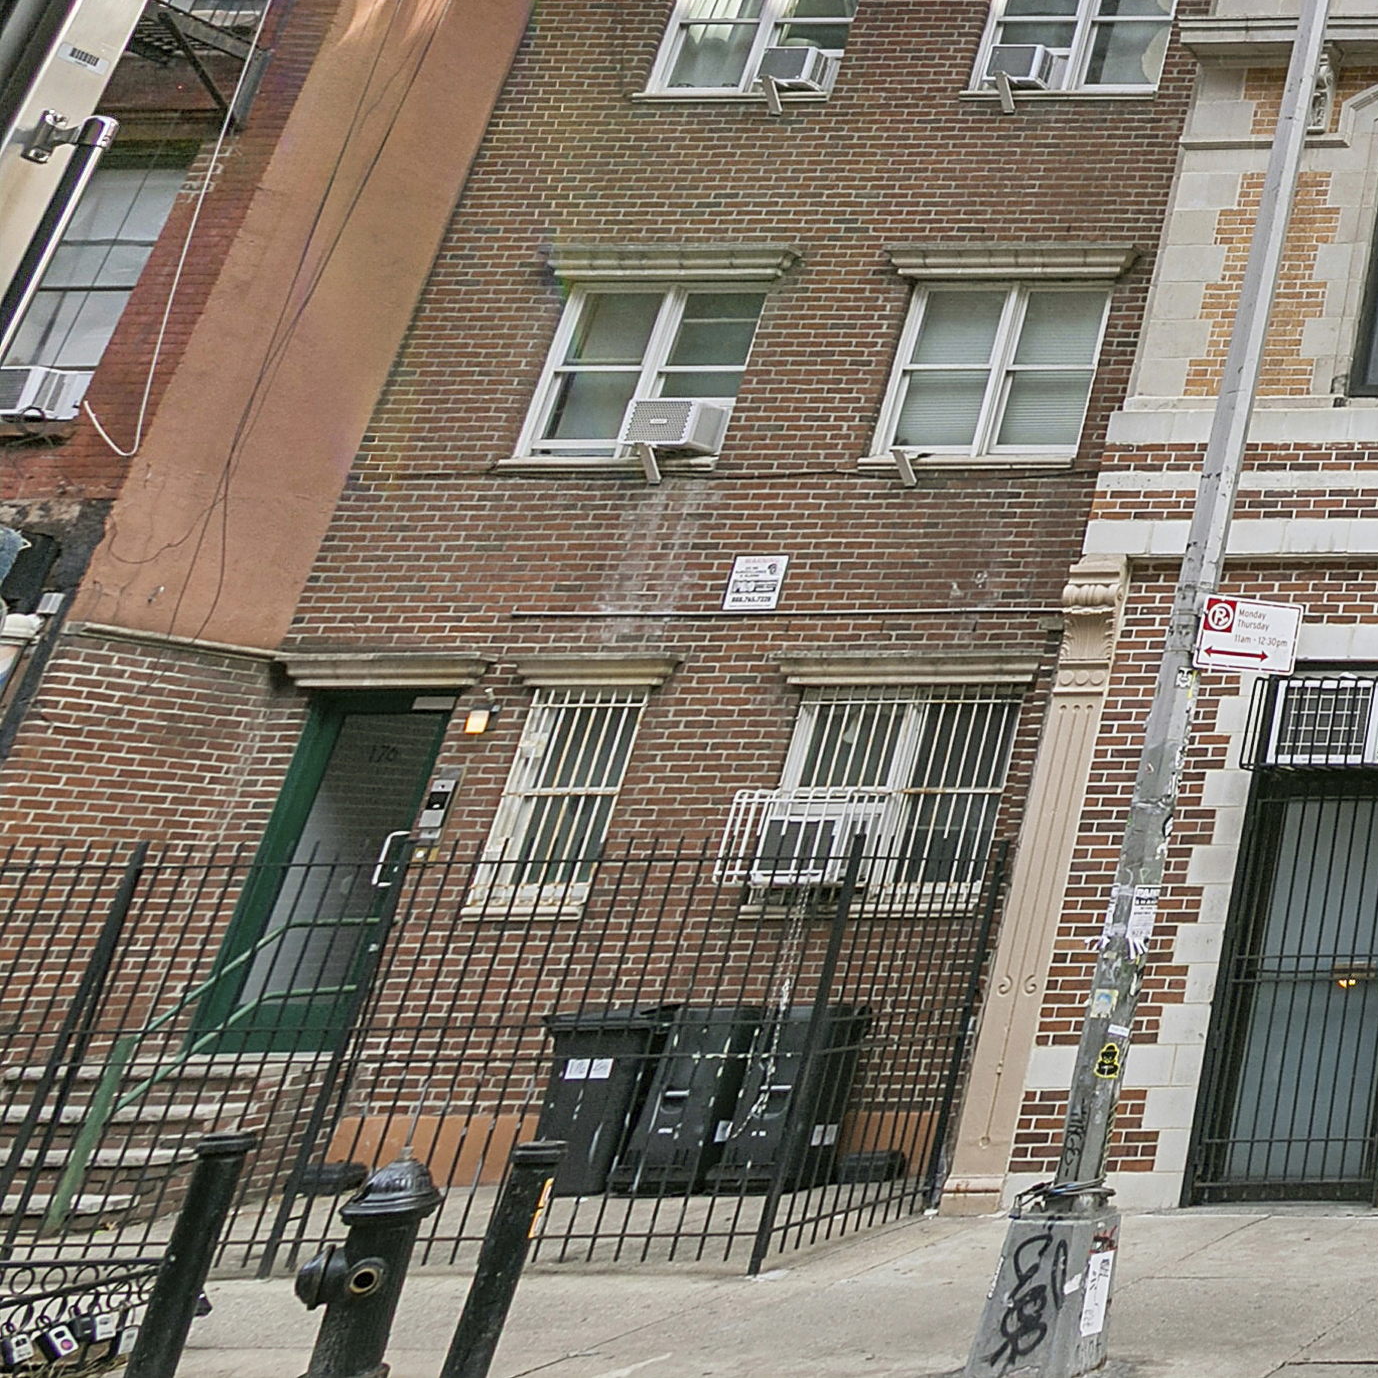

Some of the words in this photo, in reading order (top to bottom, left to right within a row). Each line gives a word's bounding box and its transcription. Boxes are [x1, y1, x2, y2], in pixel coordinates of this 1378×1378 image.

[1239, 609, 1267, 620] Monday
[1237, 619, 1270, 631] Thursday
[1234, 634, 1252, 643] 11am
[1258, 636, 1288, 648] 12:30pm
